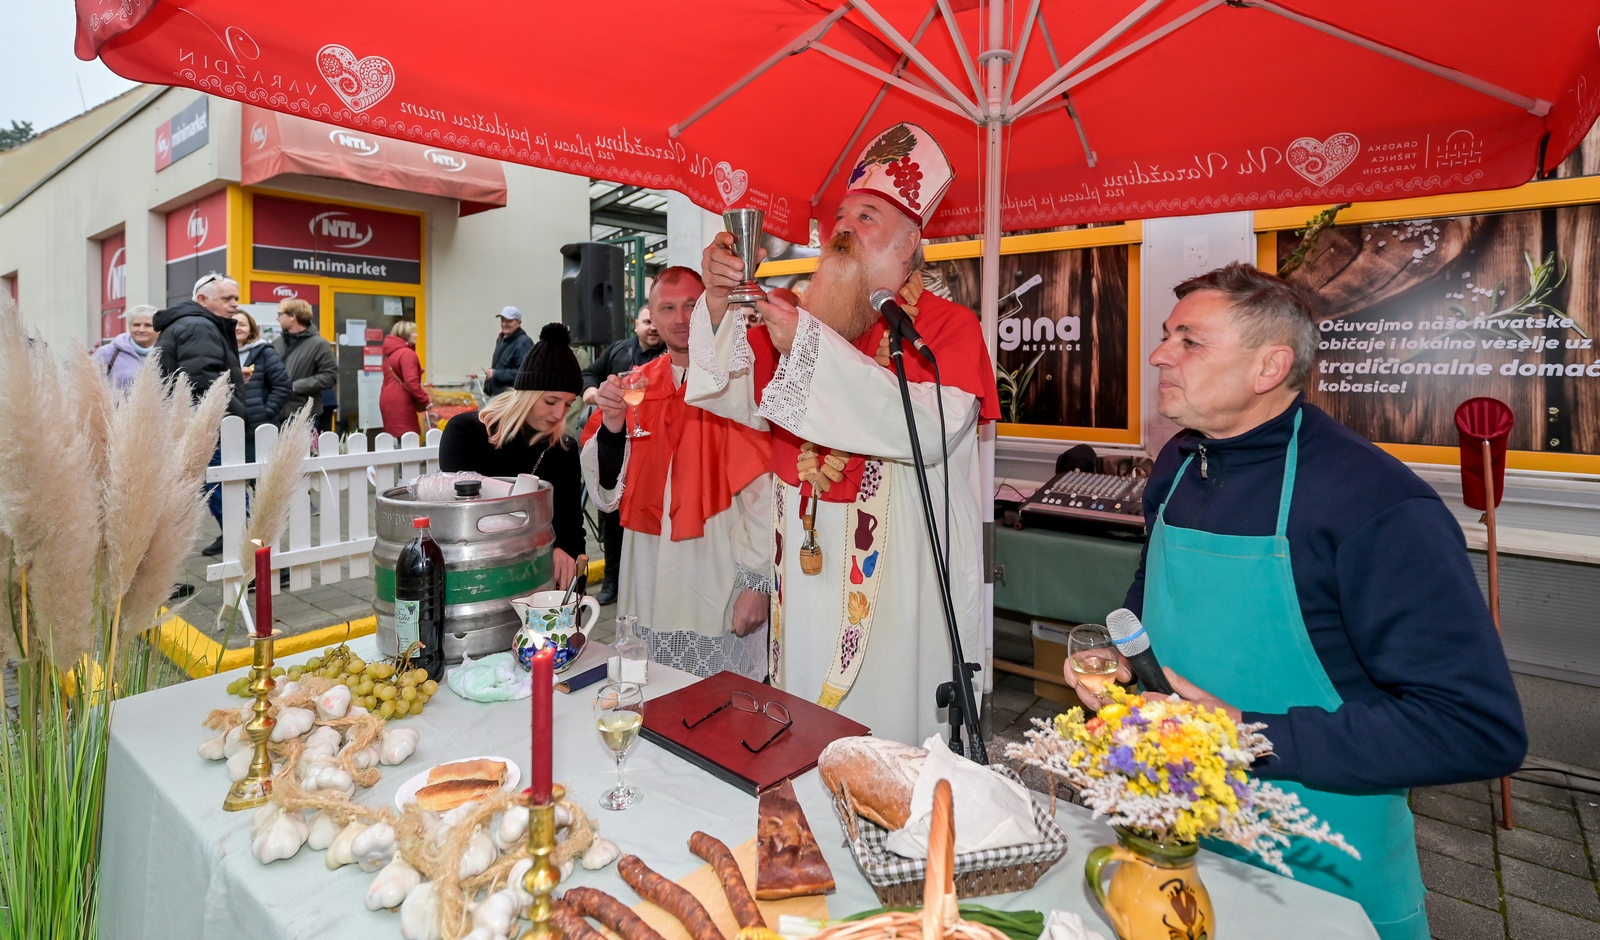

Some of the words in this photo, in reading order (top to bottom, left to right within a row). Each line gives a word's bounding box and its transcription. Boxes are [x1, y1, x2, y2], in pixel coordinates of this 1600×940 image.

[338, 132, 372, 151] NTL
[432, 152, 459, 168] NTL
[322, 218, 363, 240] NTL
[293, 255, 387, 277] minimarket
[1318, 318, 1414, 335] Očuvajmo
[1418, 316, 1467, 331] naše
[1473, 314, 1574, 330] hrvatske
[1022, 343, 1081, 351] MESNICE
[1318, 337, 1386, 353] običaje
[1390, 337, 1398, 350] i
[1400, 337, 1476, 350] lokalno
[1481, 335, 1560, 354] veselje
[1564, 338, 1593, 350] uz
[1318, 358, 1493, 376] tradicionalne
[1318, 380, 1407, 394] kobasice!
